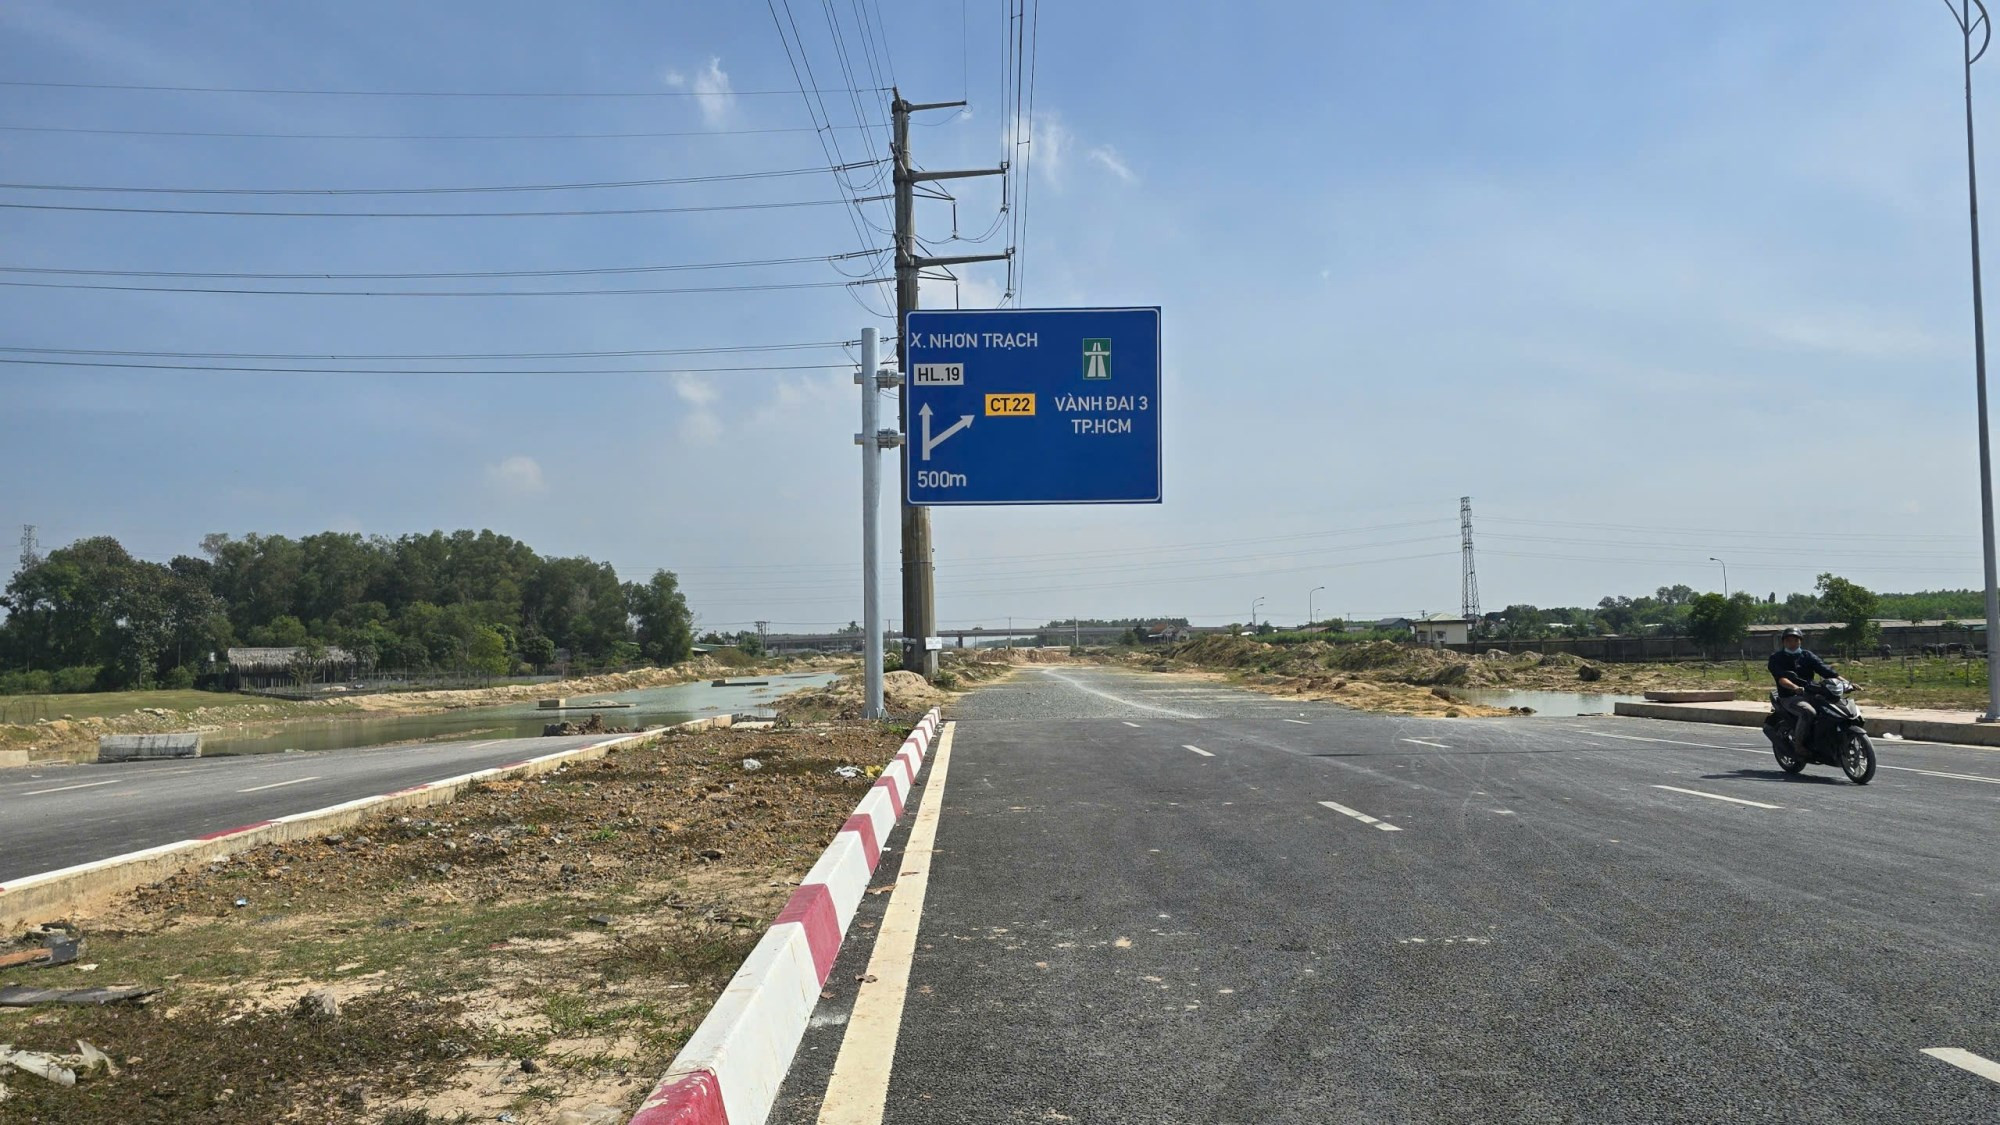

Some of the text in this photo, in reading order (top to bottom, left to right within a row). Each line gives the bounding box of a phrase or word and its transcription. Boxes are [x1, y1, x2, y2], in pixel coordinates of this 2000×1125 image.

[910, 332, 1038, 350] X. NHƠN TRẠCH
[917, 367, 960, 382] HL.19
[990, 398, 1030, 412] CT.22
[1054, 392, 1148, 411] VÀNH ĐAI 3
[1071, 418, 1132, 434] TP.HCM
[917, 471, 967, 488] 500m
